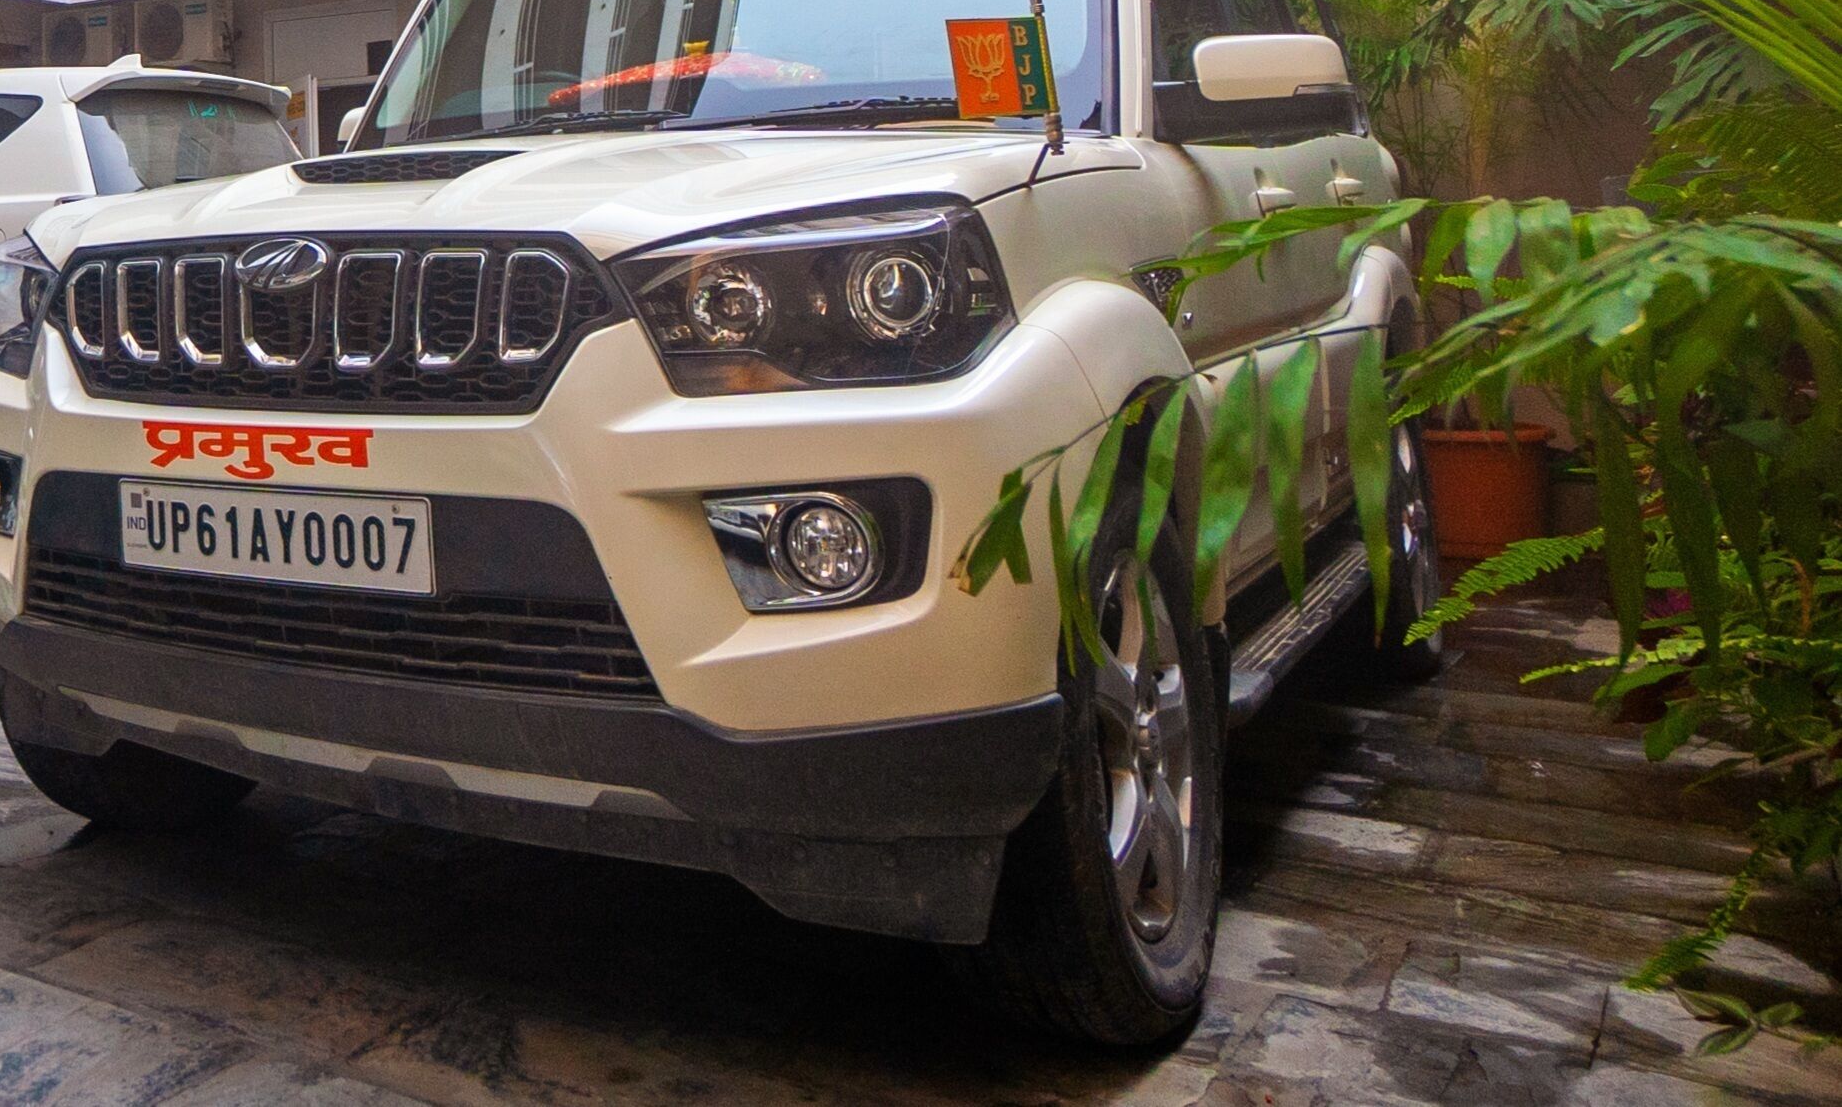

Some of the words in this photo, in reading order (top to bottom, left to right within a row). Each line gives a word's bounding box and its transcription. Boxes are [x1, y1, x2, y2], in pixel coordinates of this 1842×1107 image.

[142, 420, 374, 480] प्रमुख
[126, 515, 146, 531] IND
[145, 499, 416, 574] UP61AY0007
